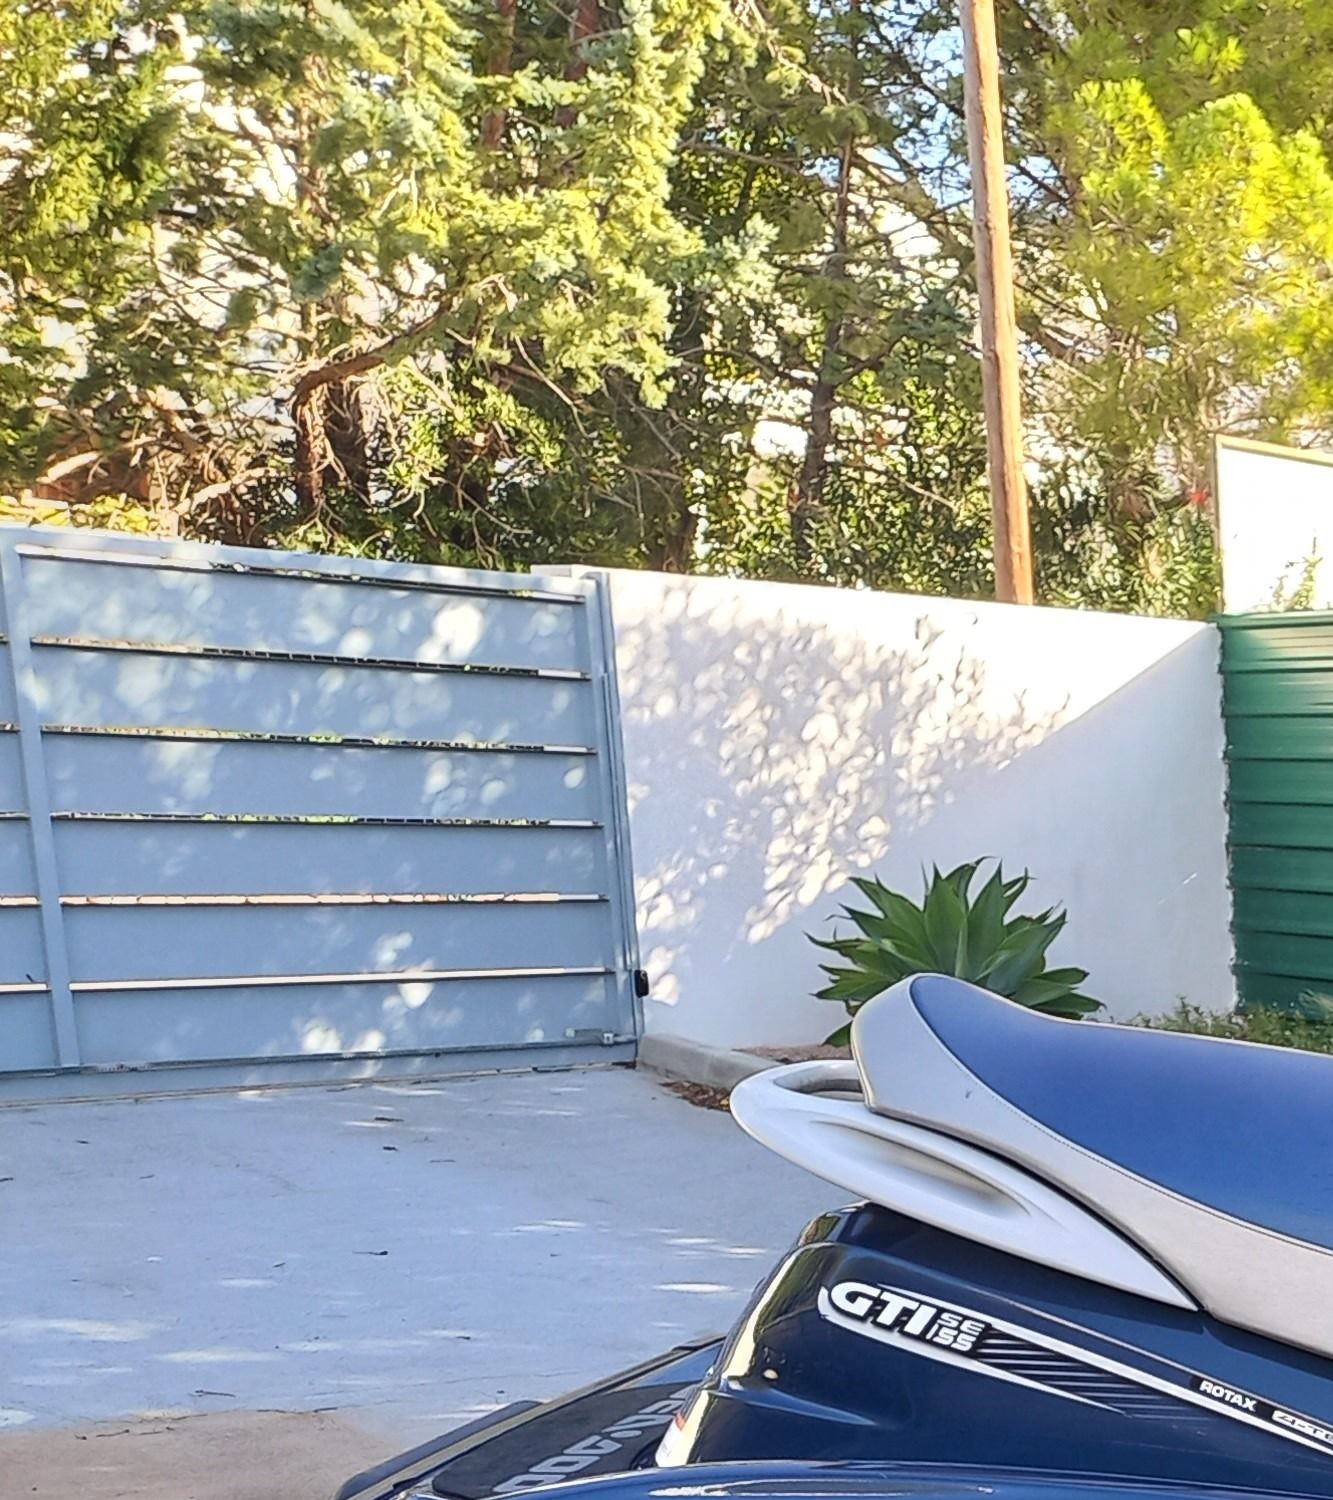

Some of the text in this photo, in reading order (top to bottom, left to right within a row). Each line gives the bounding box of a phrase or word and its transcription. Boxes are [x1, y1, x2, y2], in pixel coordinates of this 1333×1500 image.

[830, 1281, 938, 1336] GTI
[936, 1311, 986, 1337] SE
[1198, 1379, 1259, 1413] ROTAX
